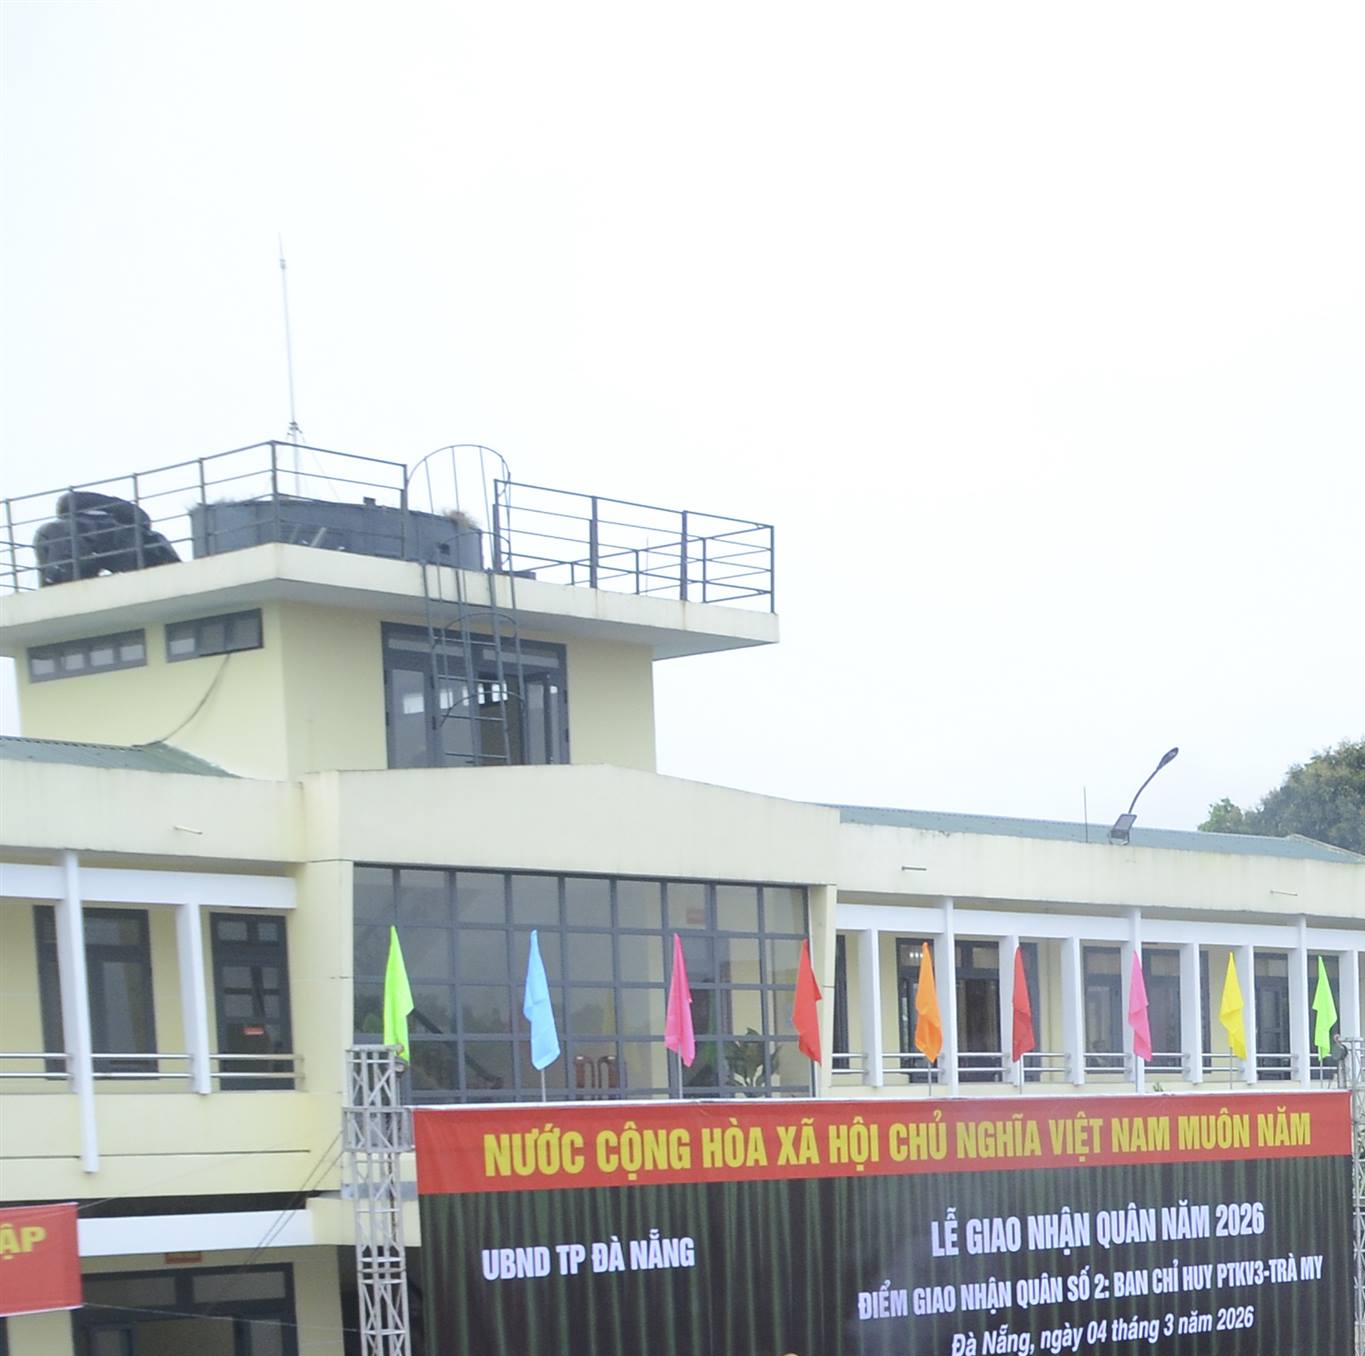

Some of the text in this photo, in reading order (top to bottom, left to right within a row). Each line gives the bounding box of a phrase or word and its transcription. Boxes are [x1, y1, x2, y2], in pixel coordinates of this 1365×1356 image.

[484, 1107, 1311, 1181] NƯỚC CỘNG HÒA XÃ HỘI CHỦ NGHĨA VIỆT NAM MUÔN NĂM
[0, 1223, 47, 1260] ẬP
[482, 1229, 694, 1280] UBND TP ĐÀ NẴNG
[931, 1200, 1264, 1256] LỄ GIAO NHẬN QUÂN NĂM 2026
[858, 1253, 1322, 1319] ĐIỂM GIAO NHẬN QUÂN SỐ 2: BAN CHỈ HUY PTKV3-TRÀ MY
[982, 1325, 1034, 1356] Nẵng,
[1041, 1323, 1083, 1353] ngày
[1087, 1320, 1106, 1344] 04
[1112, 1316, 1159, 1343] tháng
[1164, 1314, 1174, 1335] 3
[1178, 1311, 1212, 1334] năm
[1217, 1306, 1254, 1330] 2026
